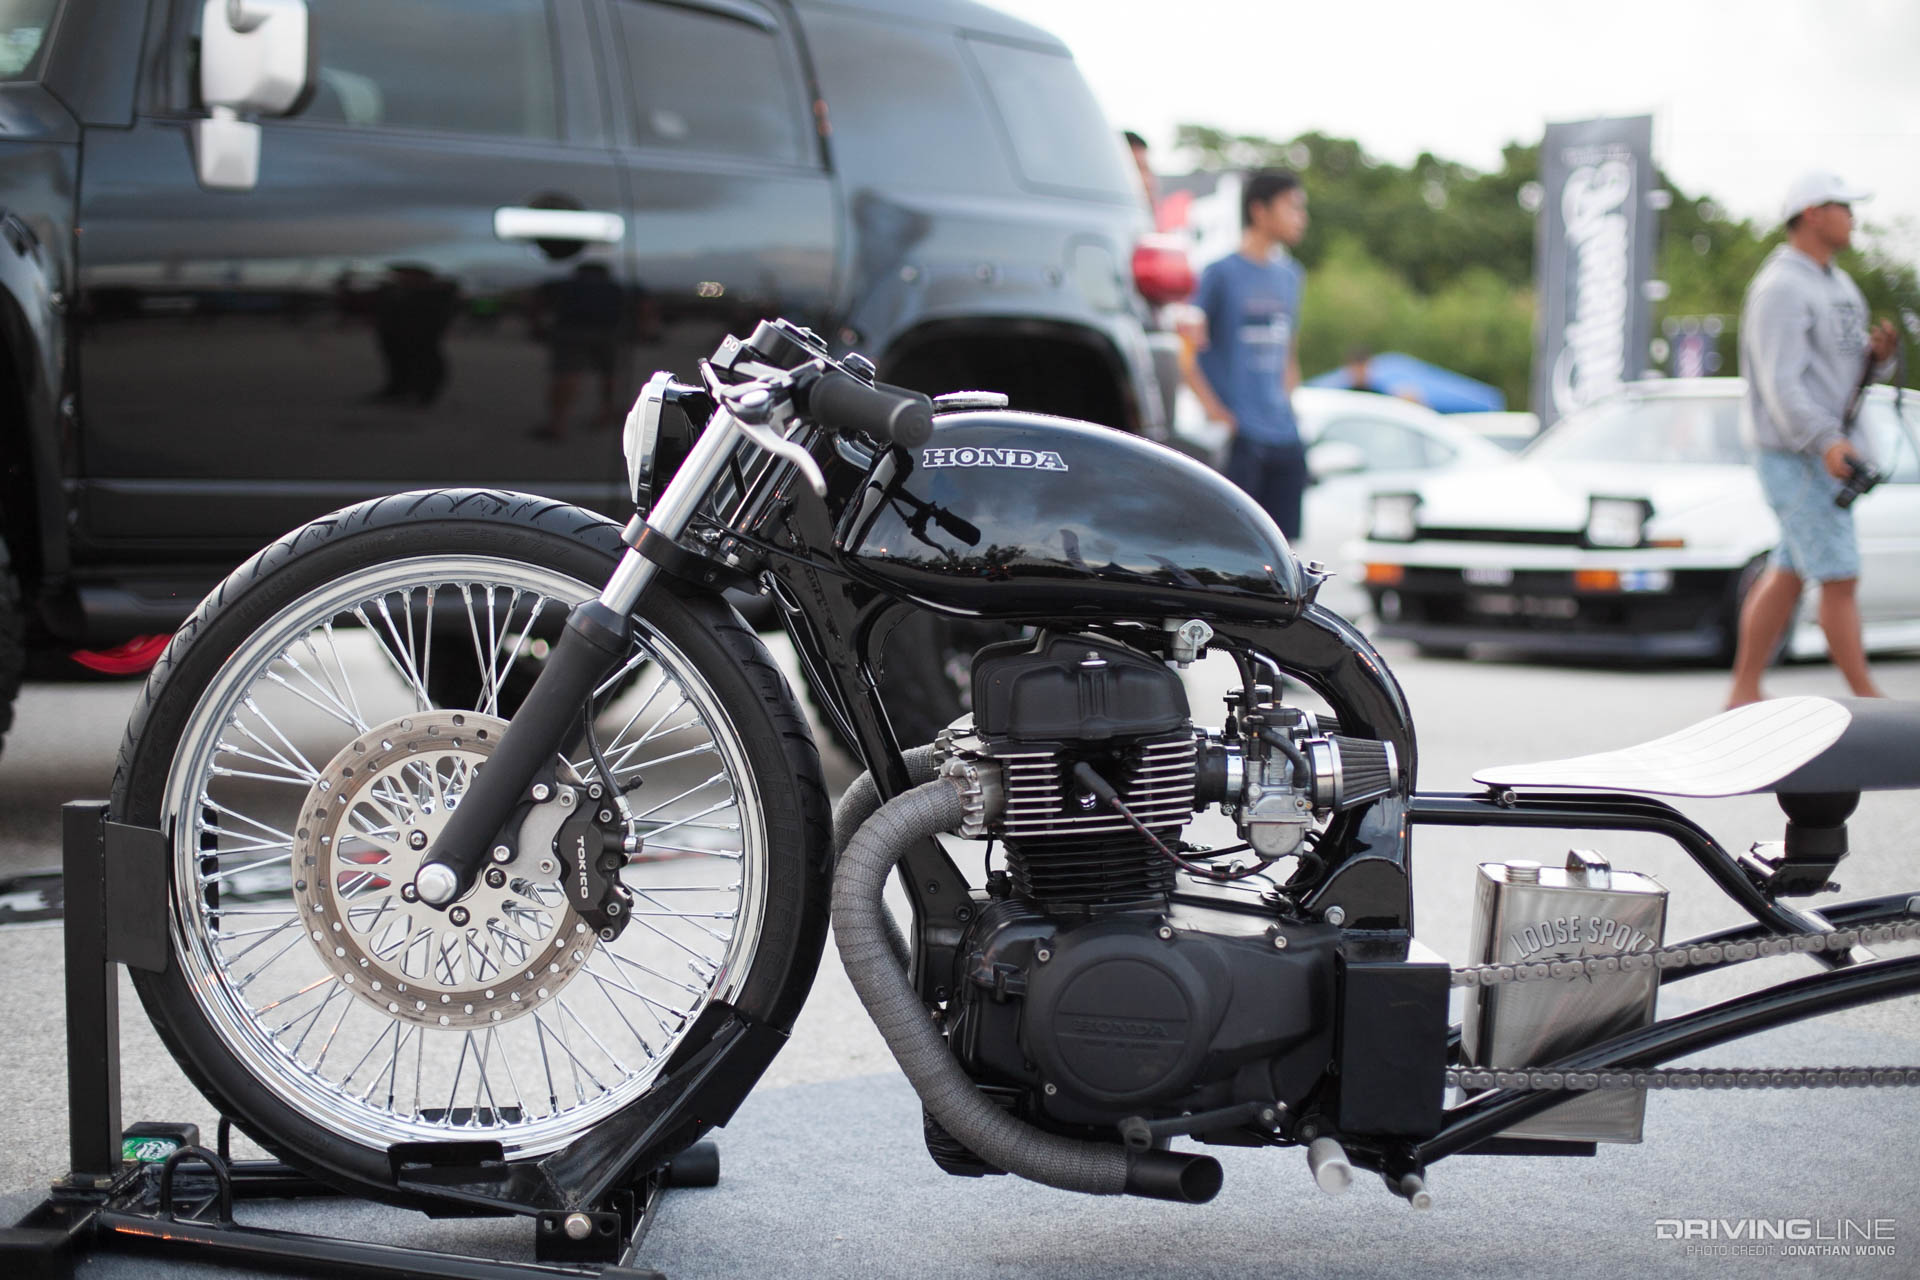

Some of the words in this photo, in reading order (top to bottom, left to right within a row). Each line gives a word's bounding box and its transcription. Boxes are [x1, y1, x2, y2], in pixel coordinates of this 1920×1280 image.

[923, 447, 1068, 472] HONDA
[576, 835, 589, 899] TOKICO
[1510, 914, 1581, 960] LOOSE
[1071, 1018, 1169, 1037] HONDA
